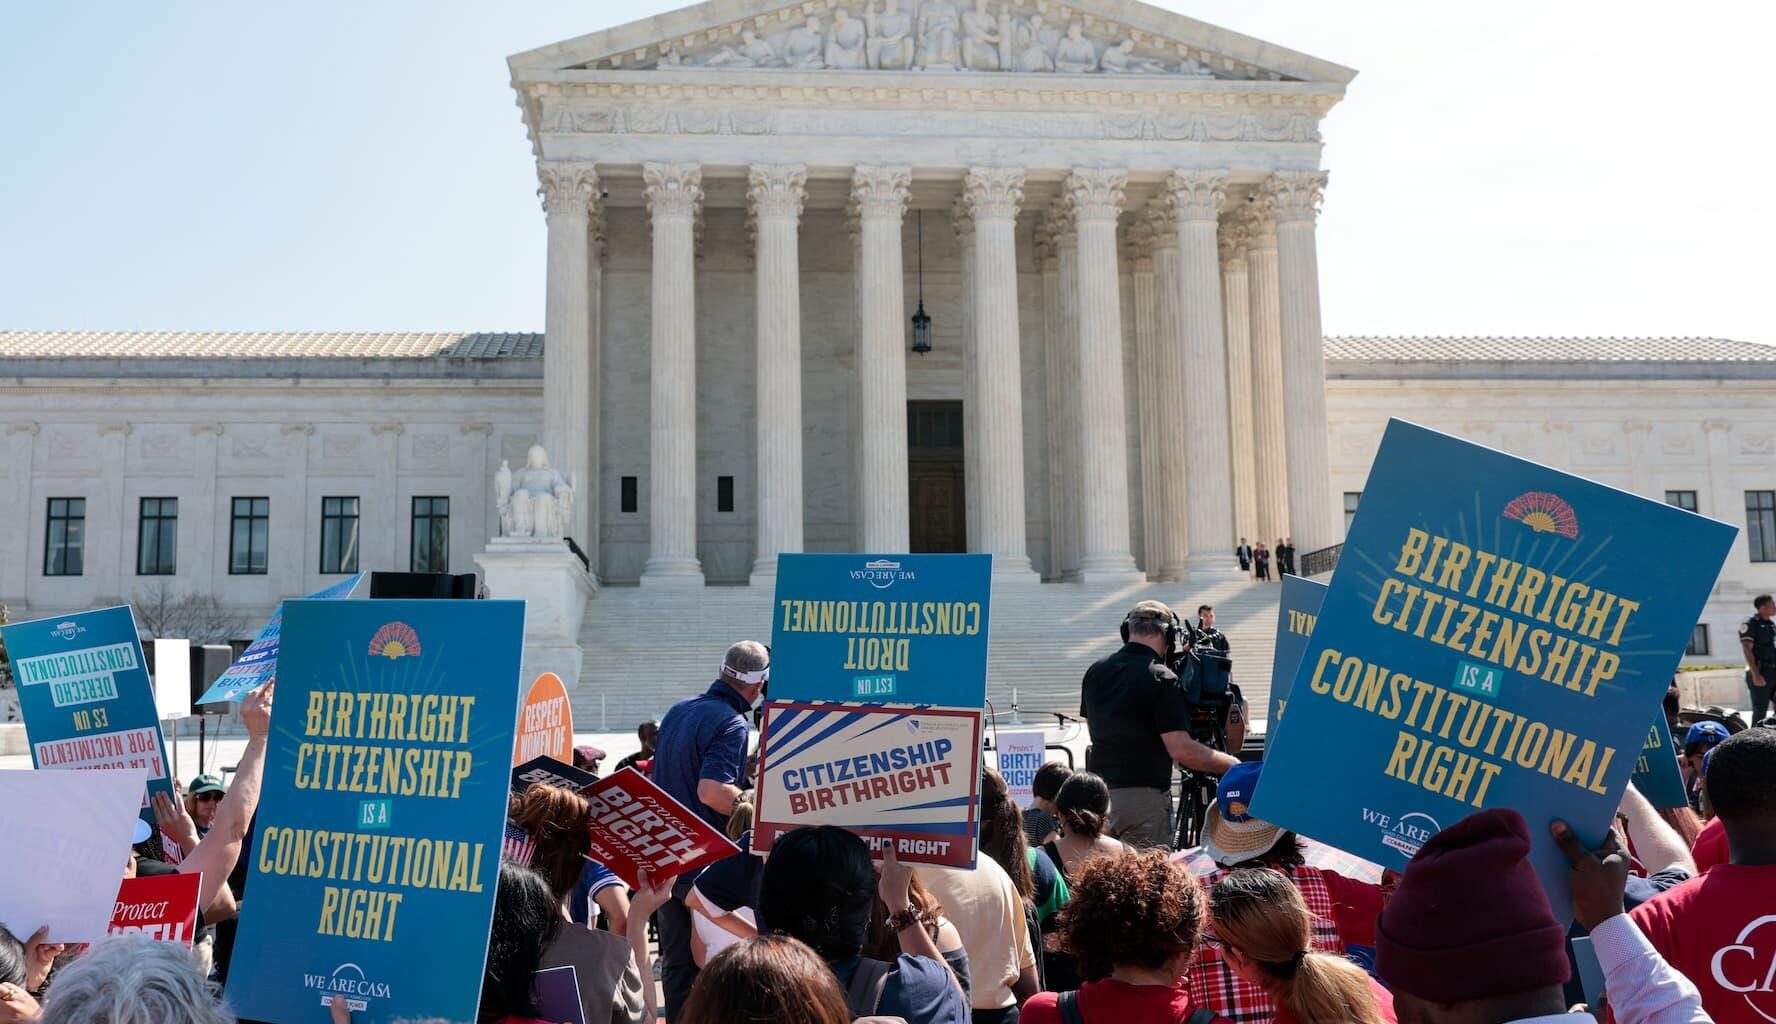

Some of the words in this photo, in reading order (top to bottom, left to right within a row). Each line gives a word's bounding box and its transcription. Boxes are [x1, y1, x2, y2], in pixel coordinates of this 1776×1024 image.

[850, 571, 875, 580] CASA
[876, 571, 897, 580] ARE
[899, 571, 915, 580] WE
[1395, 528, 1639, 646] BIRTHRIGHT
[781, 600, 981, 635] CONSTITUTIONNEL
[1372, 578, 1620, 696] CITIZENSHIP
[22, 646, 133, 682] CONSTITUCIONAL
[238, 651, 269, 663] KEEP
[843, 637, 910, 671] DROIT
[55, 676, 113, 703] DERECHO
[857, 679, 872, 694] UN
[875, 678, 893, 693] EST
[1460, 665, 1478, 688] IS
[1480, 673, 1495, 693] A
[73, 709, 91, 731] UN
[94, 707, 108, 729] ES
[305, 691, 475, 743] BIRTHRIGHT
[525, 696, 564, 734] RESPECT
[1310, 648, 1616, 794] CONSTITUTIONAL
[41, 735, 124, 766] NACIMIENTO
[128, 730, 156, 754] POR
[521, 728, 551, 762] WOMEN
[553, 726, 566, 756] OF
[152, 756, 161, 777] A
[295, 743, 472, 798] CITIZENSHIP
[782, 738, 953, 792] CITIZENSHIP
[1001, 753, 1041, 769] BIRTH
[1385, 731, 1502, 808] RIGHT
[789, 762, 952, 816] BIRTHRIGHT
[1002, 770, 1038, 786] RIGH
[362, 802, 374, 824] IS
[378, 802, 387, 823] A
[598, 785, 707, 860] BIRTH
[637, 796, 700, 837] Protect
[1363, 807, 1391, 828] WE
[1392, 822, 1430, 844] ARE
[588, 796, 686, 867] RIGHT
[898, 838, 951, 856] RIGHT
[258, 826, 485, 892] CONSTITUTIONAL
[112, 901, 169, 921] Protect
[317, 887, 403, 941] RIGHT
[304, 974, 325, 989] WE
[328, 977, 356, 993] ARE
[357, 981, 391, 999] CASA
